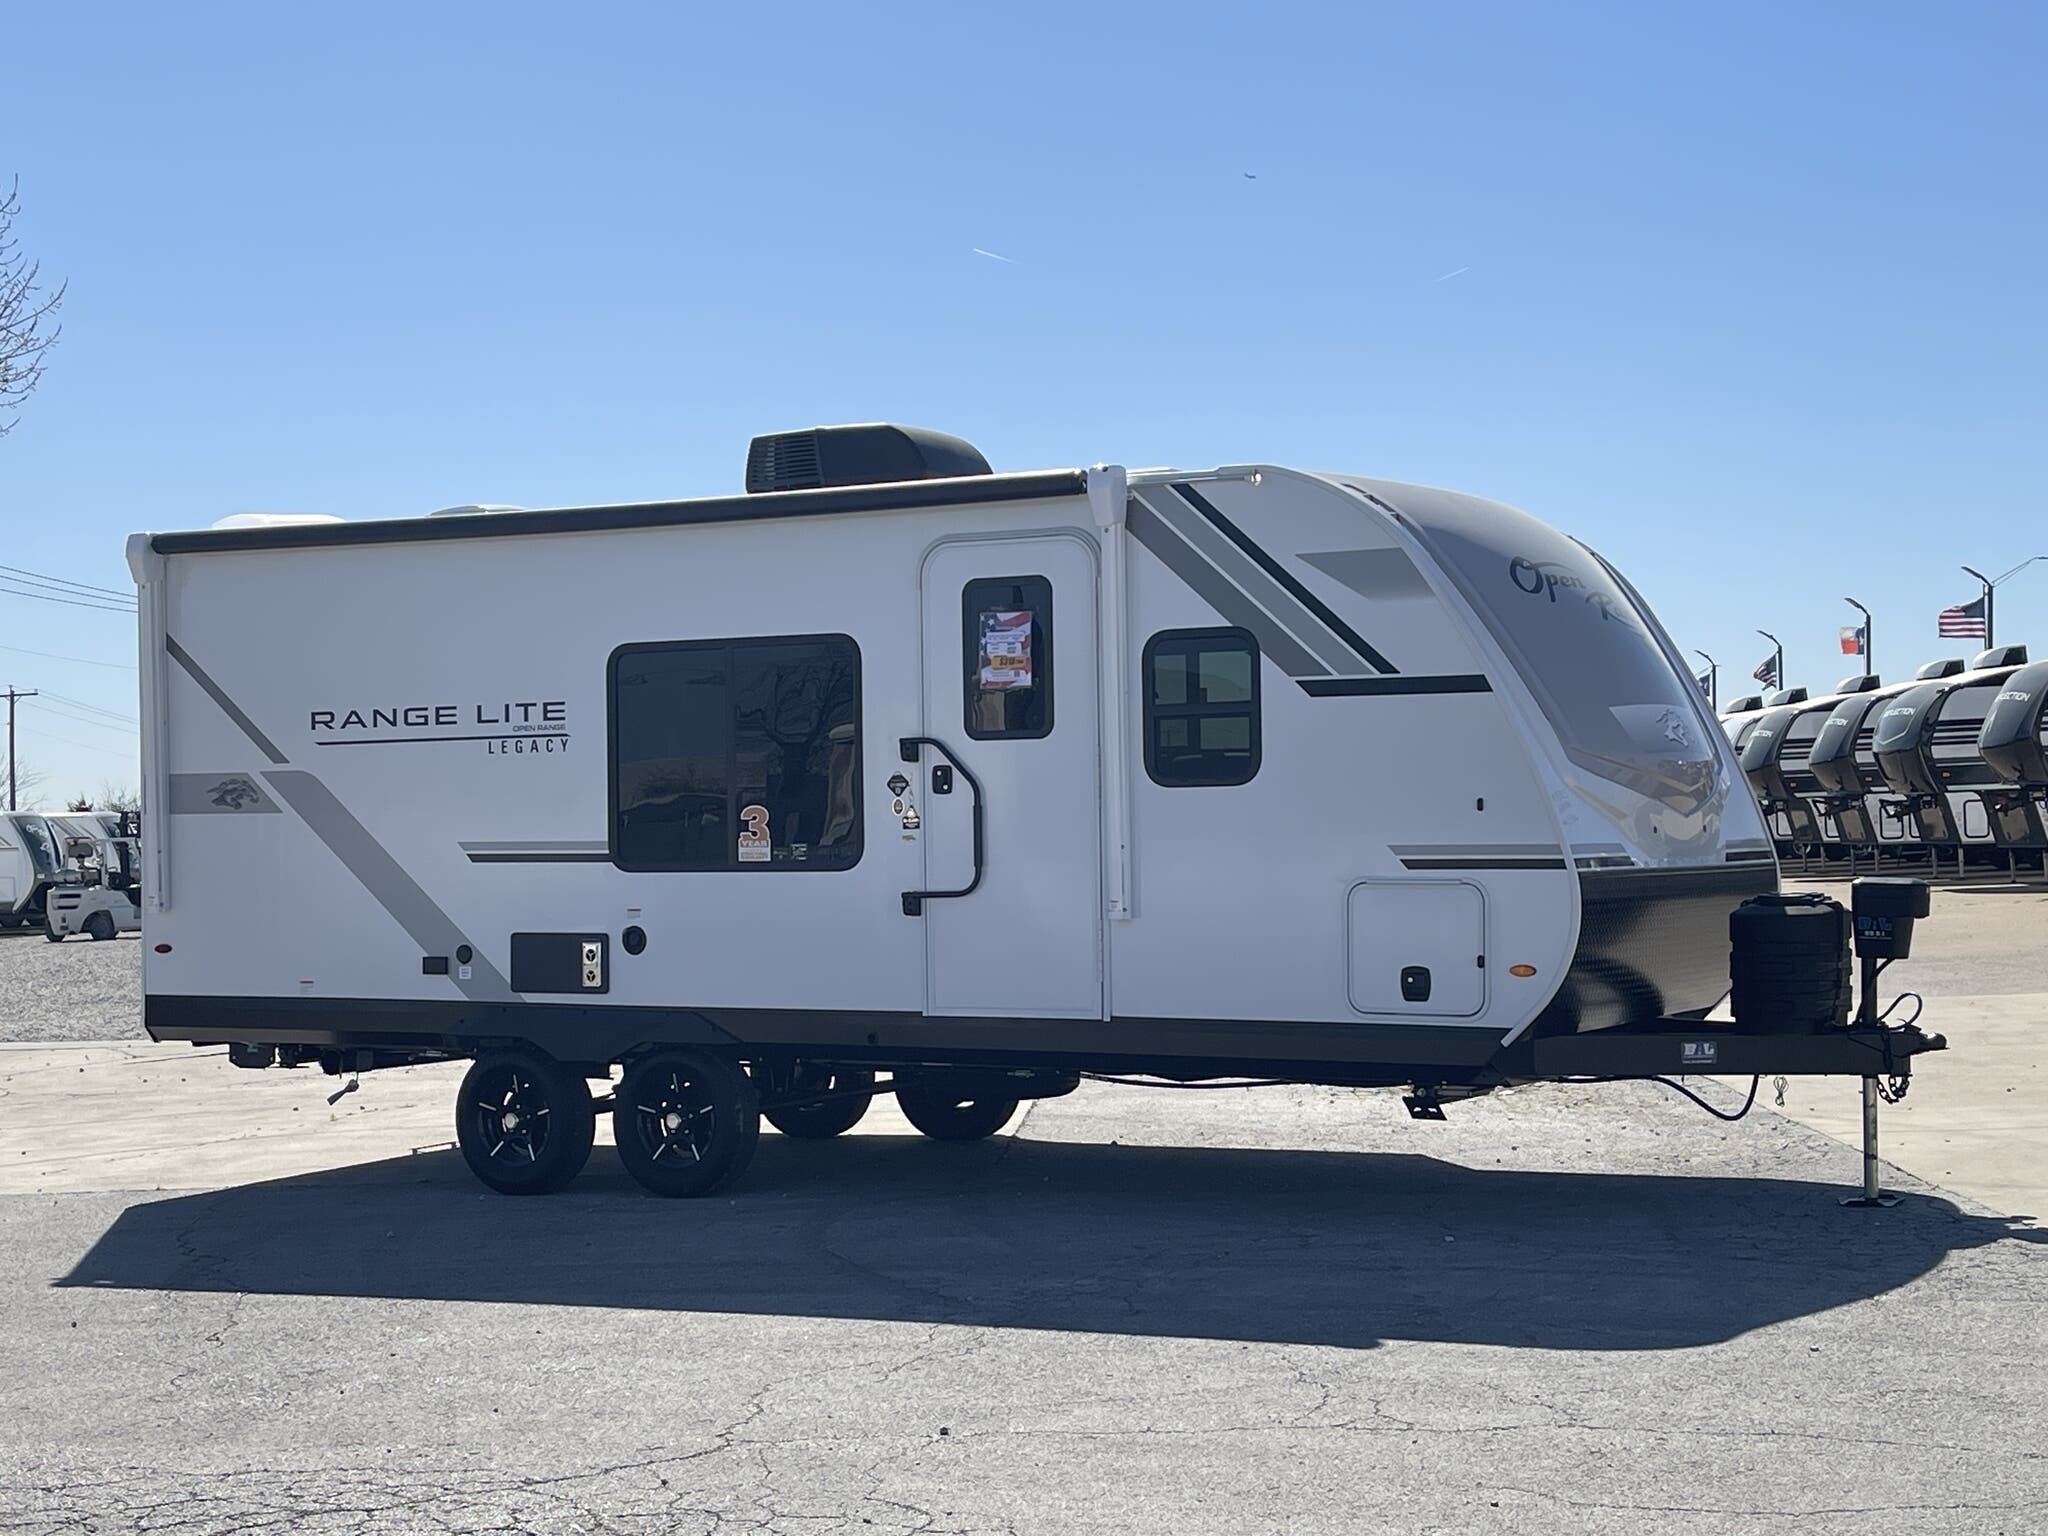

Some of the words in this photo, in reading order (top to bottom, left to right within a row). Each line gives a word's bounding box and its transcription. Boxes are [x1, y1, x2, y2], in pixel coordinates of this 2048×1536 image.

[1509, 556, 1586, 603] Open
[310, 705, 458, 731] RANGE
[476, 701, 566, 724] LITE
[512, 725, 536, 733] OPEN
[537, 723, 567, 732] RANGE
[487, 738, 570, 755] LEGACY
[740, 805, 770, 840] 3
[741, 840, 768, 848] YEAR
